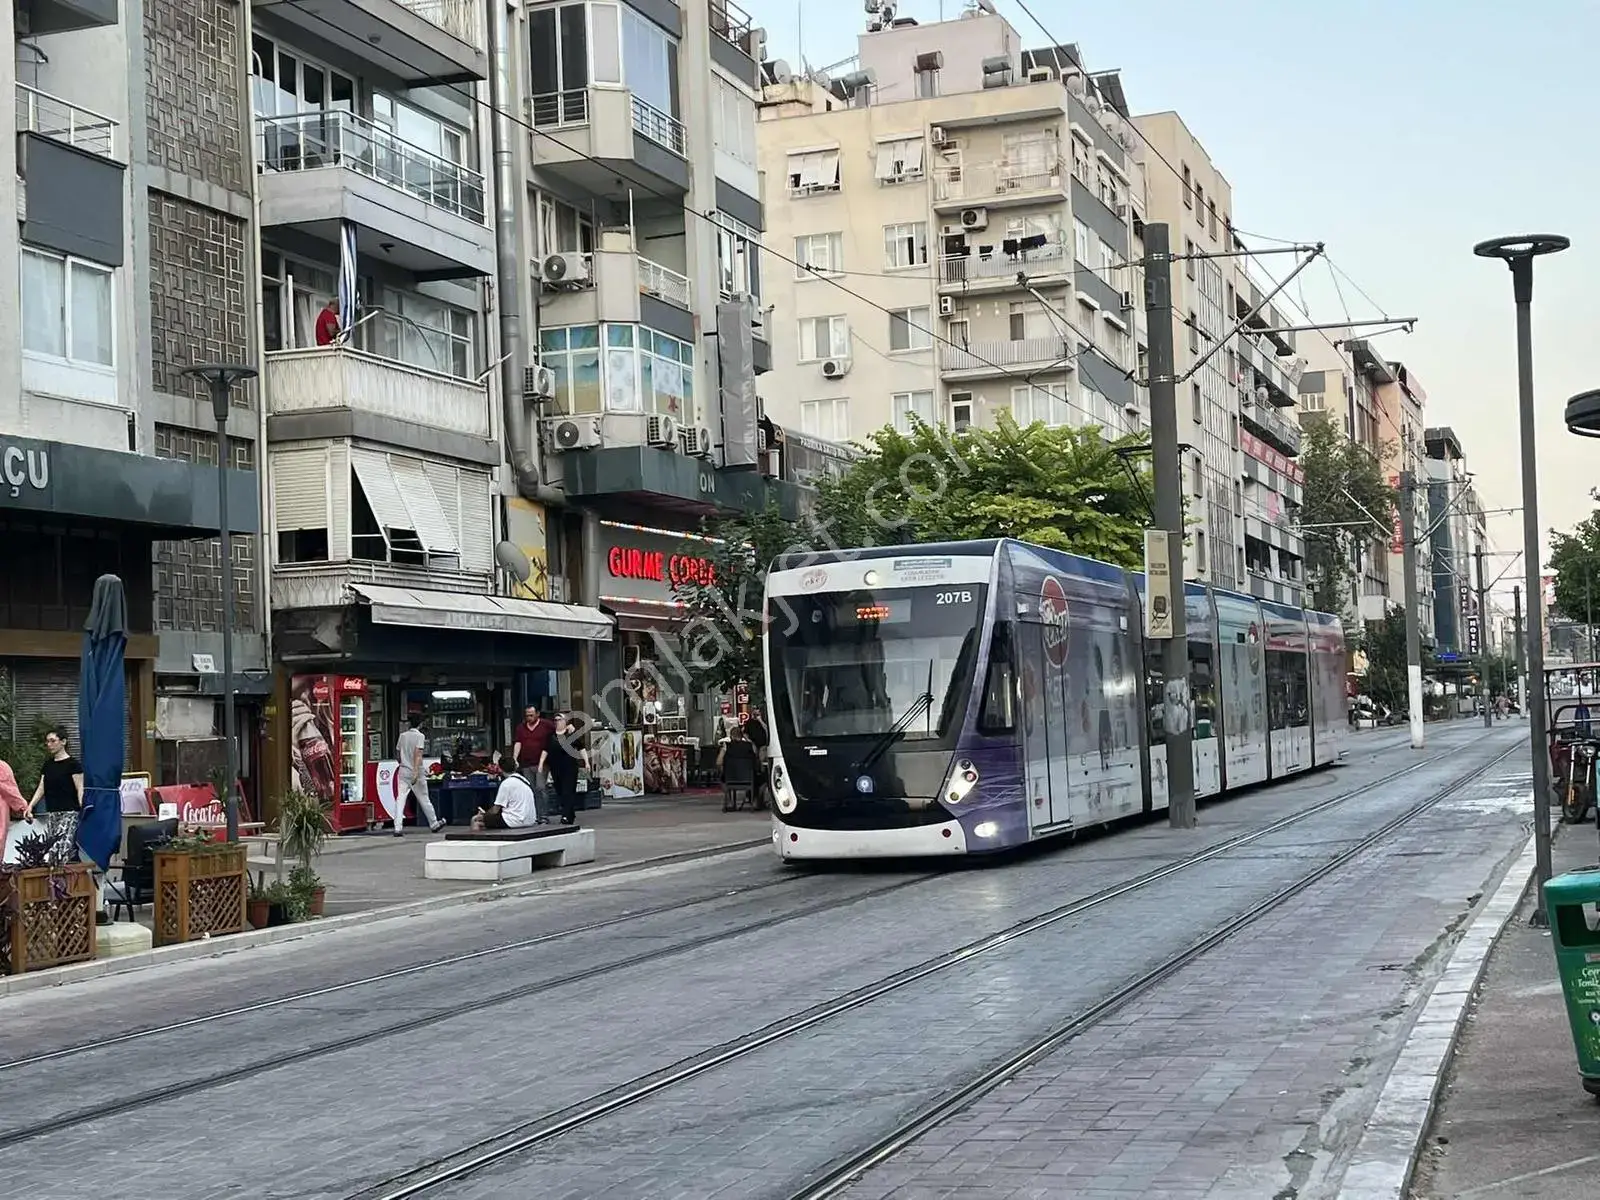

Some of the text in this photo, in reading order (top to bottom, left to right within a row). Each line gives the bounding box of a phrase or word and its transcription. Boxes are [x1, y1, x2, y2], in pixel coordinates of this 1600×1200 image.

[0, 446, 49, 497] ÇU
[700, 473, 715, 493] ON
[608, 546, 664, 581] GURME
[936, 591, 972, 605] 207B
[1469, 620, 1478, 653] HOTEL
